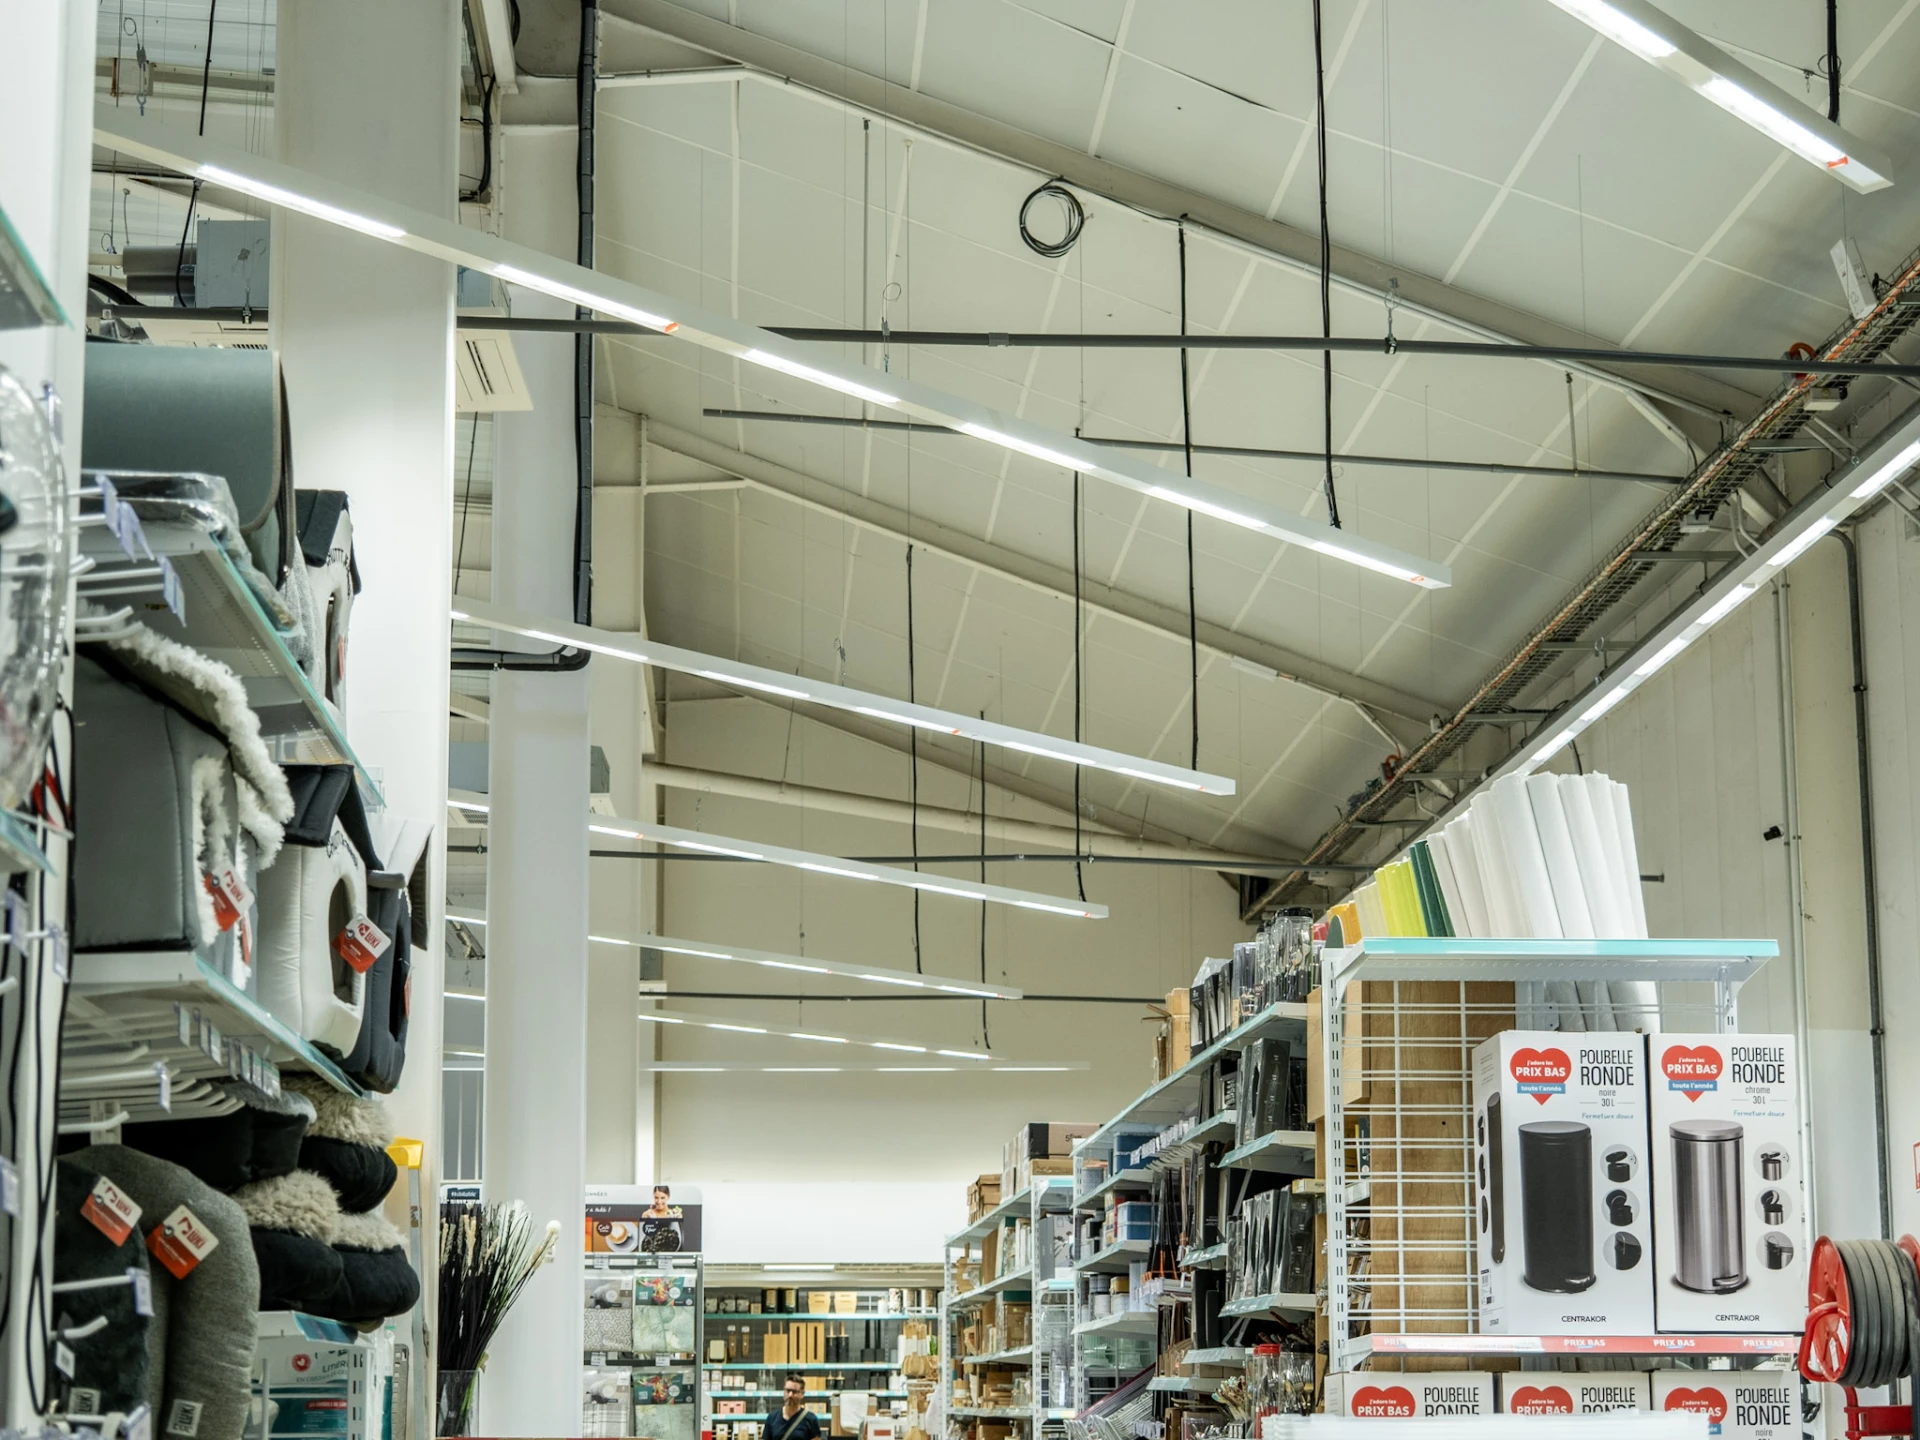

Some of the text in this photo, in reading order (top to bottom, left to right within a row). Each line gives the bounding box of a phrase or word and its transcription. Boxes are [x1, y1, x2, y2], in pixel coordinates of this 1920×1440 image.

[364, 932, 381, 949] LUKI
[1580, 1049, 1633, 1065] POUBELLE
[1731, 1047, 1785, 1062] POUBELLE
[1515, 1067, 1566, 1077] PRIX BAS
[1667, 1064, 1718, 1074] PRIX BAS
[1732, 1063, 1785, 1084] RONDE
[1580, 1066, 1634, 1086] RONDE
[1598, 1088, 1617, 1097] noire
[1745, 1086, 1771, 1094] chrome
[187, 1230, 206, 1250] LUKI
[1561, 1315, 1607, 1323] CENTRAKOR
[1715, 1314, 1760, 1322] CENTRAKOR
[1564, 1338, 1587, 1347] PRIX
[1588, 1338, 1606, 1347] BAS
[1653, 1338, 1675, 1347] PRIX
[1676, 1338, 1695, 1347] BAS
[1743, 1338, 1765, 1347] PRIX
[1766, 1338, 1785, 1347] BAS
[1424, 1387, 1480, 1403] POUBELLE
[1581, 1387, 1636, 1403] POUBELLE
[1735, 1387, 1790, 1404] POUBELLE
[1357, 1406, 1410, 1416] PRIX BAS
[1516, 1405, 1568, 1415] PRIX BAS
[1737, 1405, 1791, 1426] RONDE
[1755, 1428, 1773, 1437] noire
